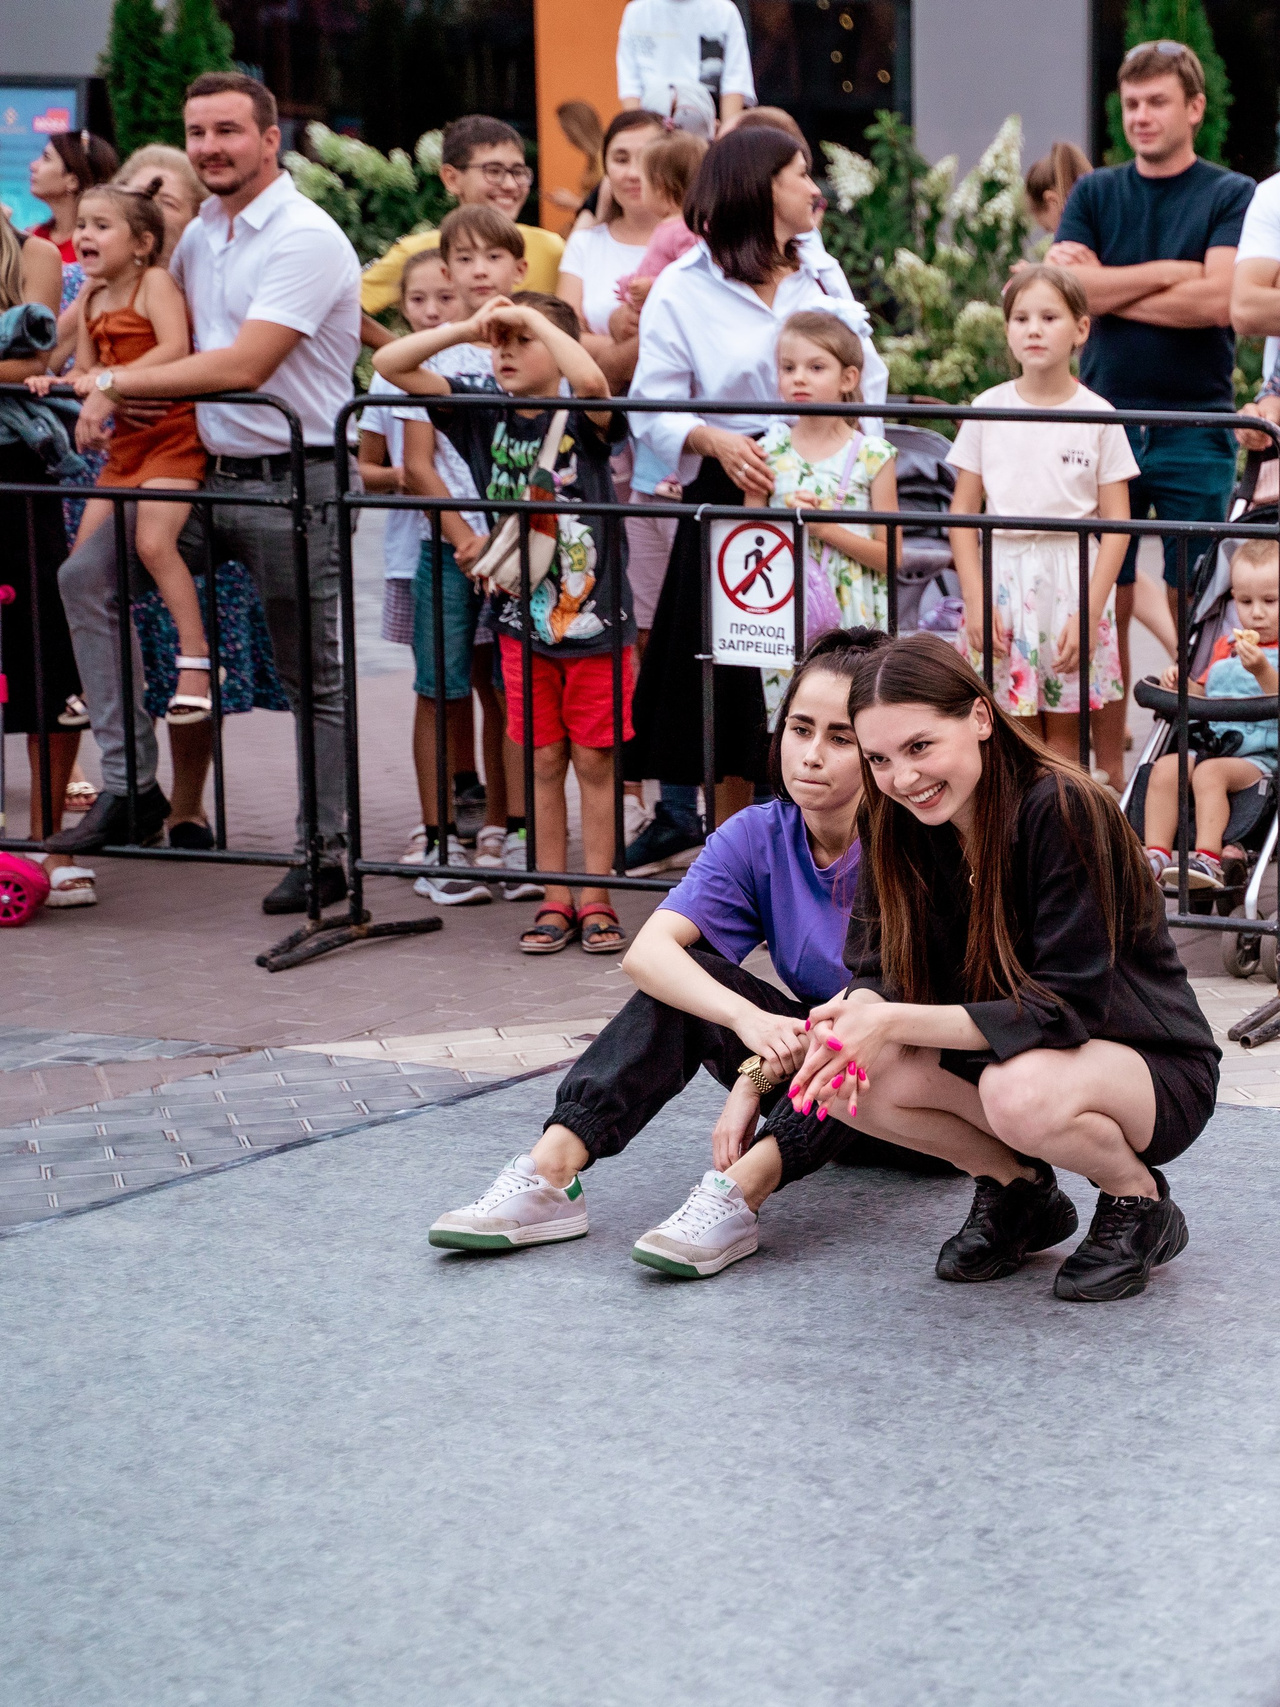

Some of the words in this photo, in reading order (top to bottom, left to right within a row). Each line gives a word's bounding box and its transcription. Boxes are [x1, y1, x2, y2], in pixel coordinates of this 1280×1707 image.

[1061, 455, 1090, 468] WINS
[730, 622, 785, 640] ПРОХОД
[718, 638, 795, 656] ЗАПРЕЩЕН
